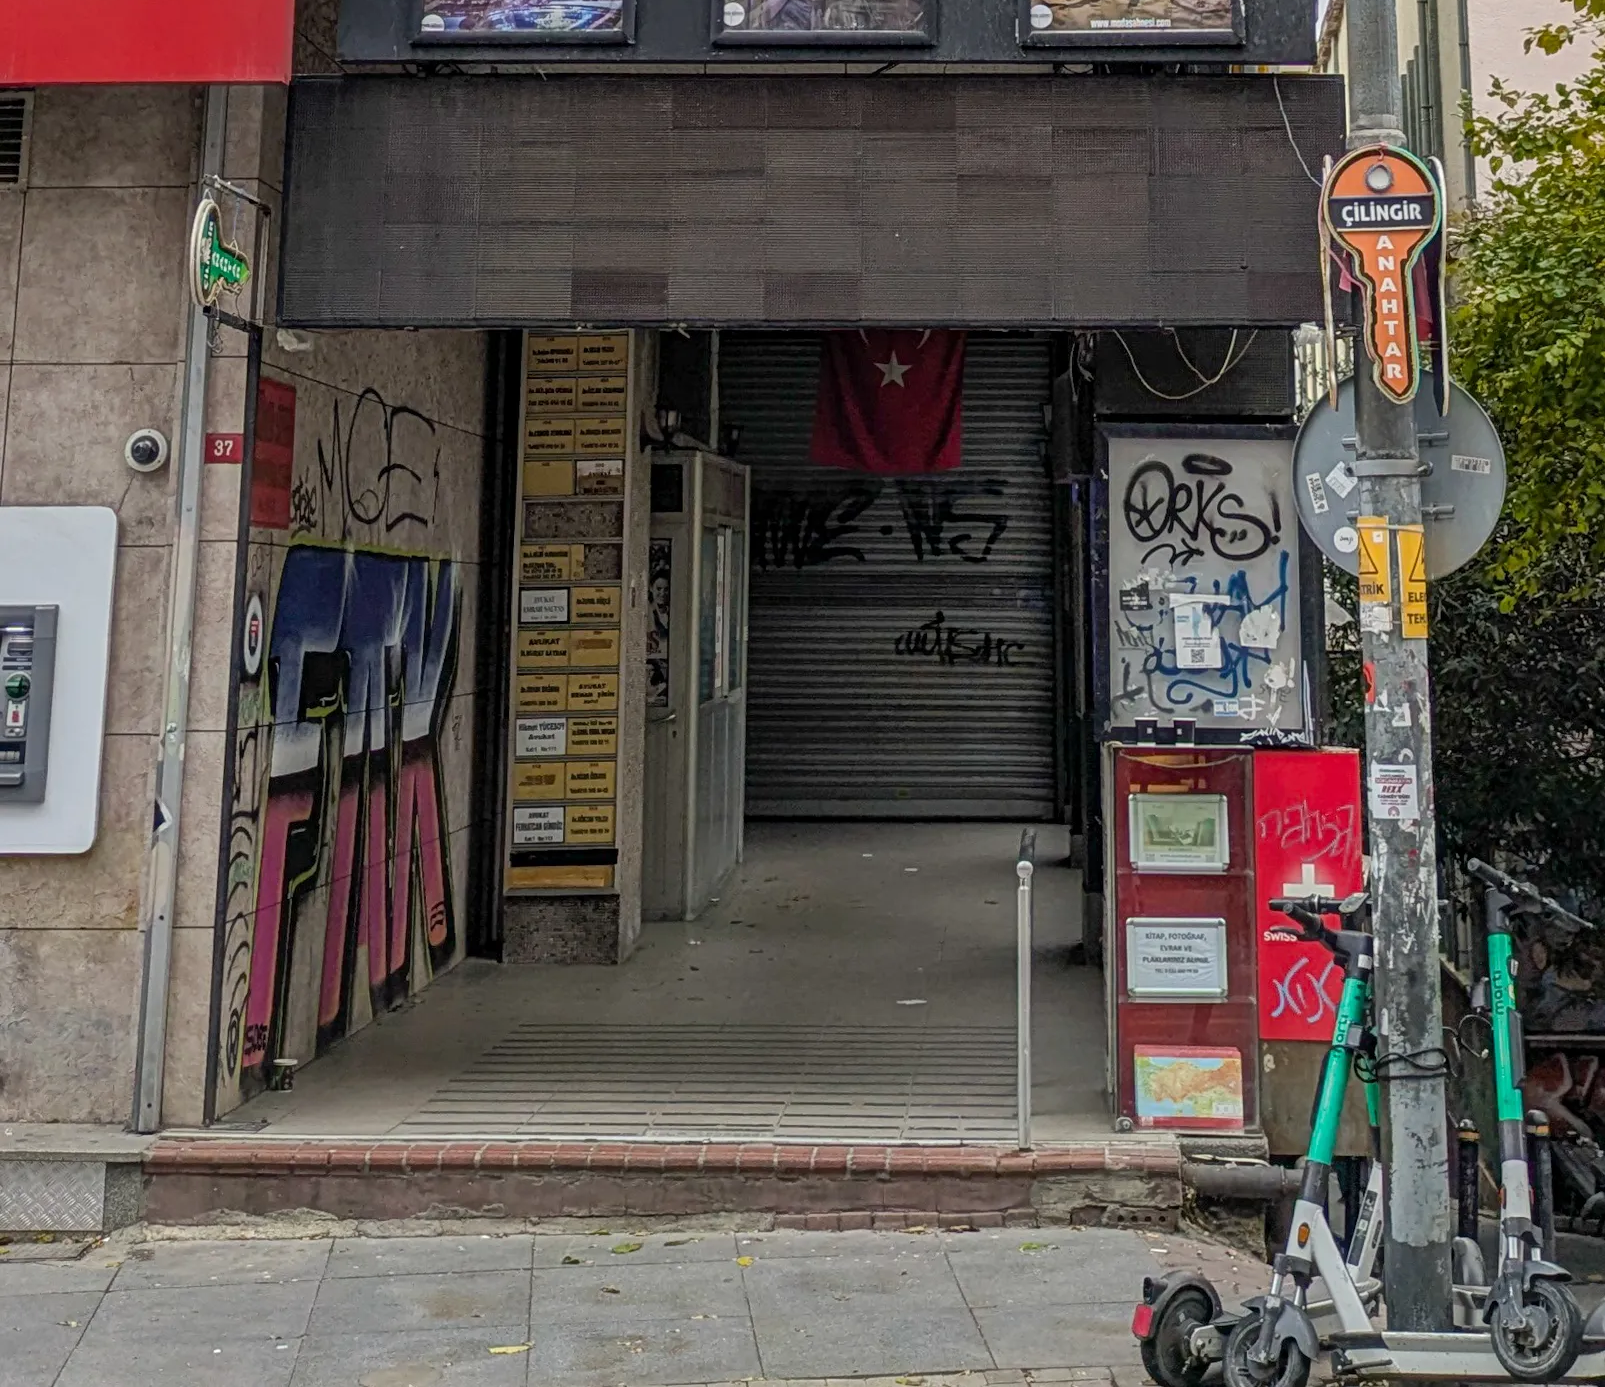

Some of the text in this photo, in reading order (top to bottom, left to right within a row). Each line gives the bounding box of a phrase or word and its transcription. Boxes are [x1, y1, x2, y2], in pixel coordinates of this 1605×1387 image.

[1341, 200, 1423, 226] ÇİLİNGİR
[1375, 234, 1403, 379] ANAHTAR
[213, 439, 234, 457] 37
[1360, 581, 1385, 596] TRİK
[1408, 592, 1427, 603] ELE
[1263, 930, 1299, 942] SWISS
